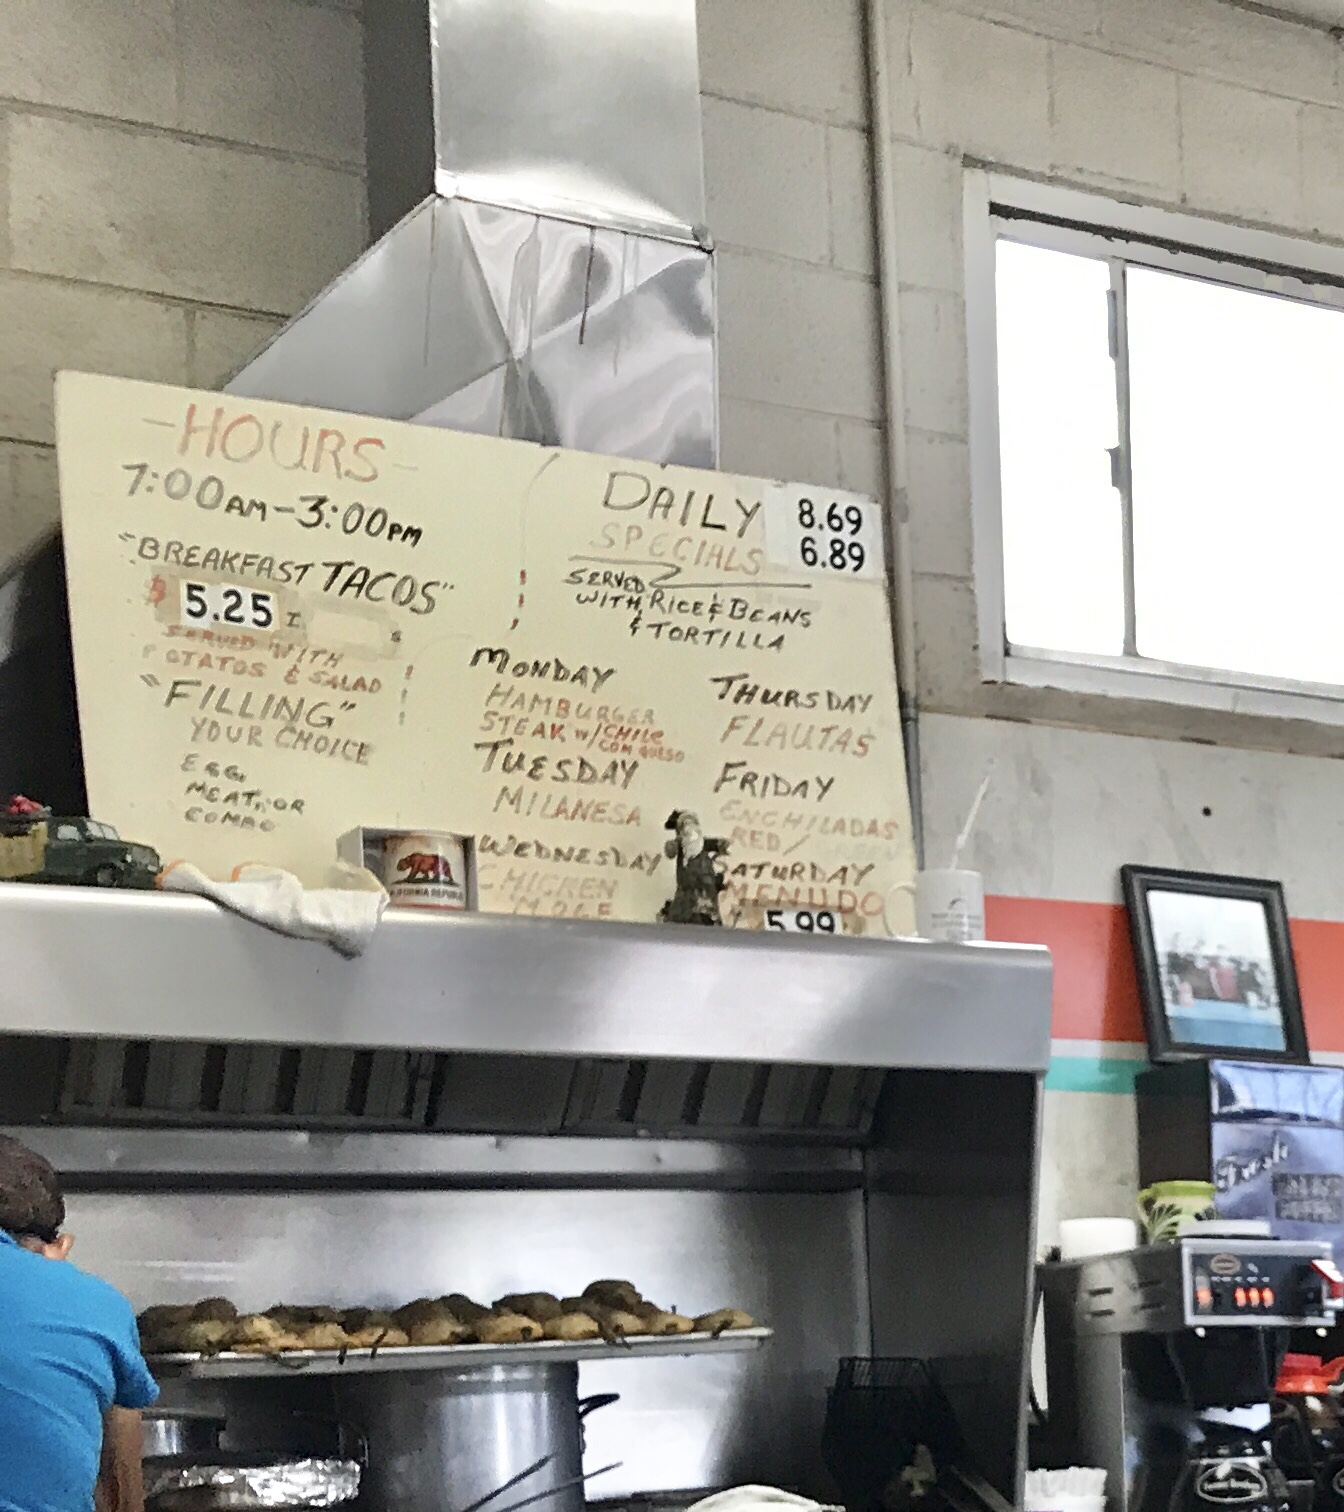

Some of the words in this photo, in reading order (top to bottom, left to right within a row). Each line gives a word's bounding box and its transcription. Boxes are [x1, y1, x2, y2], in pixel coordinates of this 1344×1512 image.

[603, 471, 762, 538] DAILY
[798, 498, 863, 535] 8.69
[590, 522, 764, 576] SPECIALS
[800, 536, 866, 573] 6.89
[564, 567, 646, 595] SERVED
[185, 582, 273, 628] 5.25
[576, 591, 640, 612] WITH
[650, 587, 705, 618] RICE
[728, 597, 812, 629] BEANS
[269, 638, 345, 669] WITH
[646, 621, 786, 651] TORTILLA
[308, 669, 383, 694] SALAD
[471, 647, 617, 693] MONDAY
[485, 681, 655, 725] HAMBURGER
[711, 673, 874, 713] THURSDAY
[190, 716, 264, 749] YOUR
[273, 724, 372, 767] CHOICE
[480, 710, 566, 743] STEAK
[719, 715, 877, 758] FLAUTAS
[474, 737, 640, 790] TUESDAY
[713, 761, 835, 803] FRIDAY
[493, 784, 641, 827] MILANESA
[719, 798, 899, 841] ENCHILADAS
[478, 833, 663, 877] WEDNESDAY
[730, 824, 781, 851] RED
[478, 864, 618, 900] CHICKEN
[718, 860, 876, 888] SATURDAY
[512, 895, 614, 918] MOLE
[725, 879, 886, 916] MENUDO
[766, 909, 835, 932] 599
